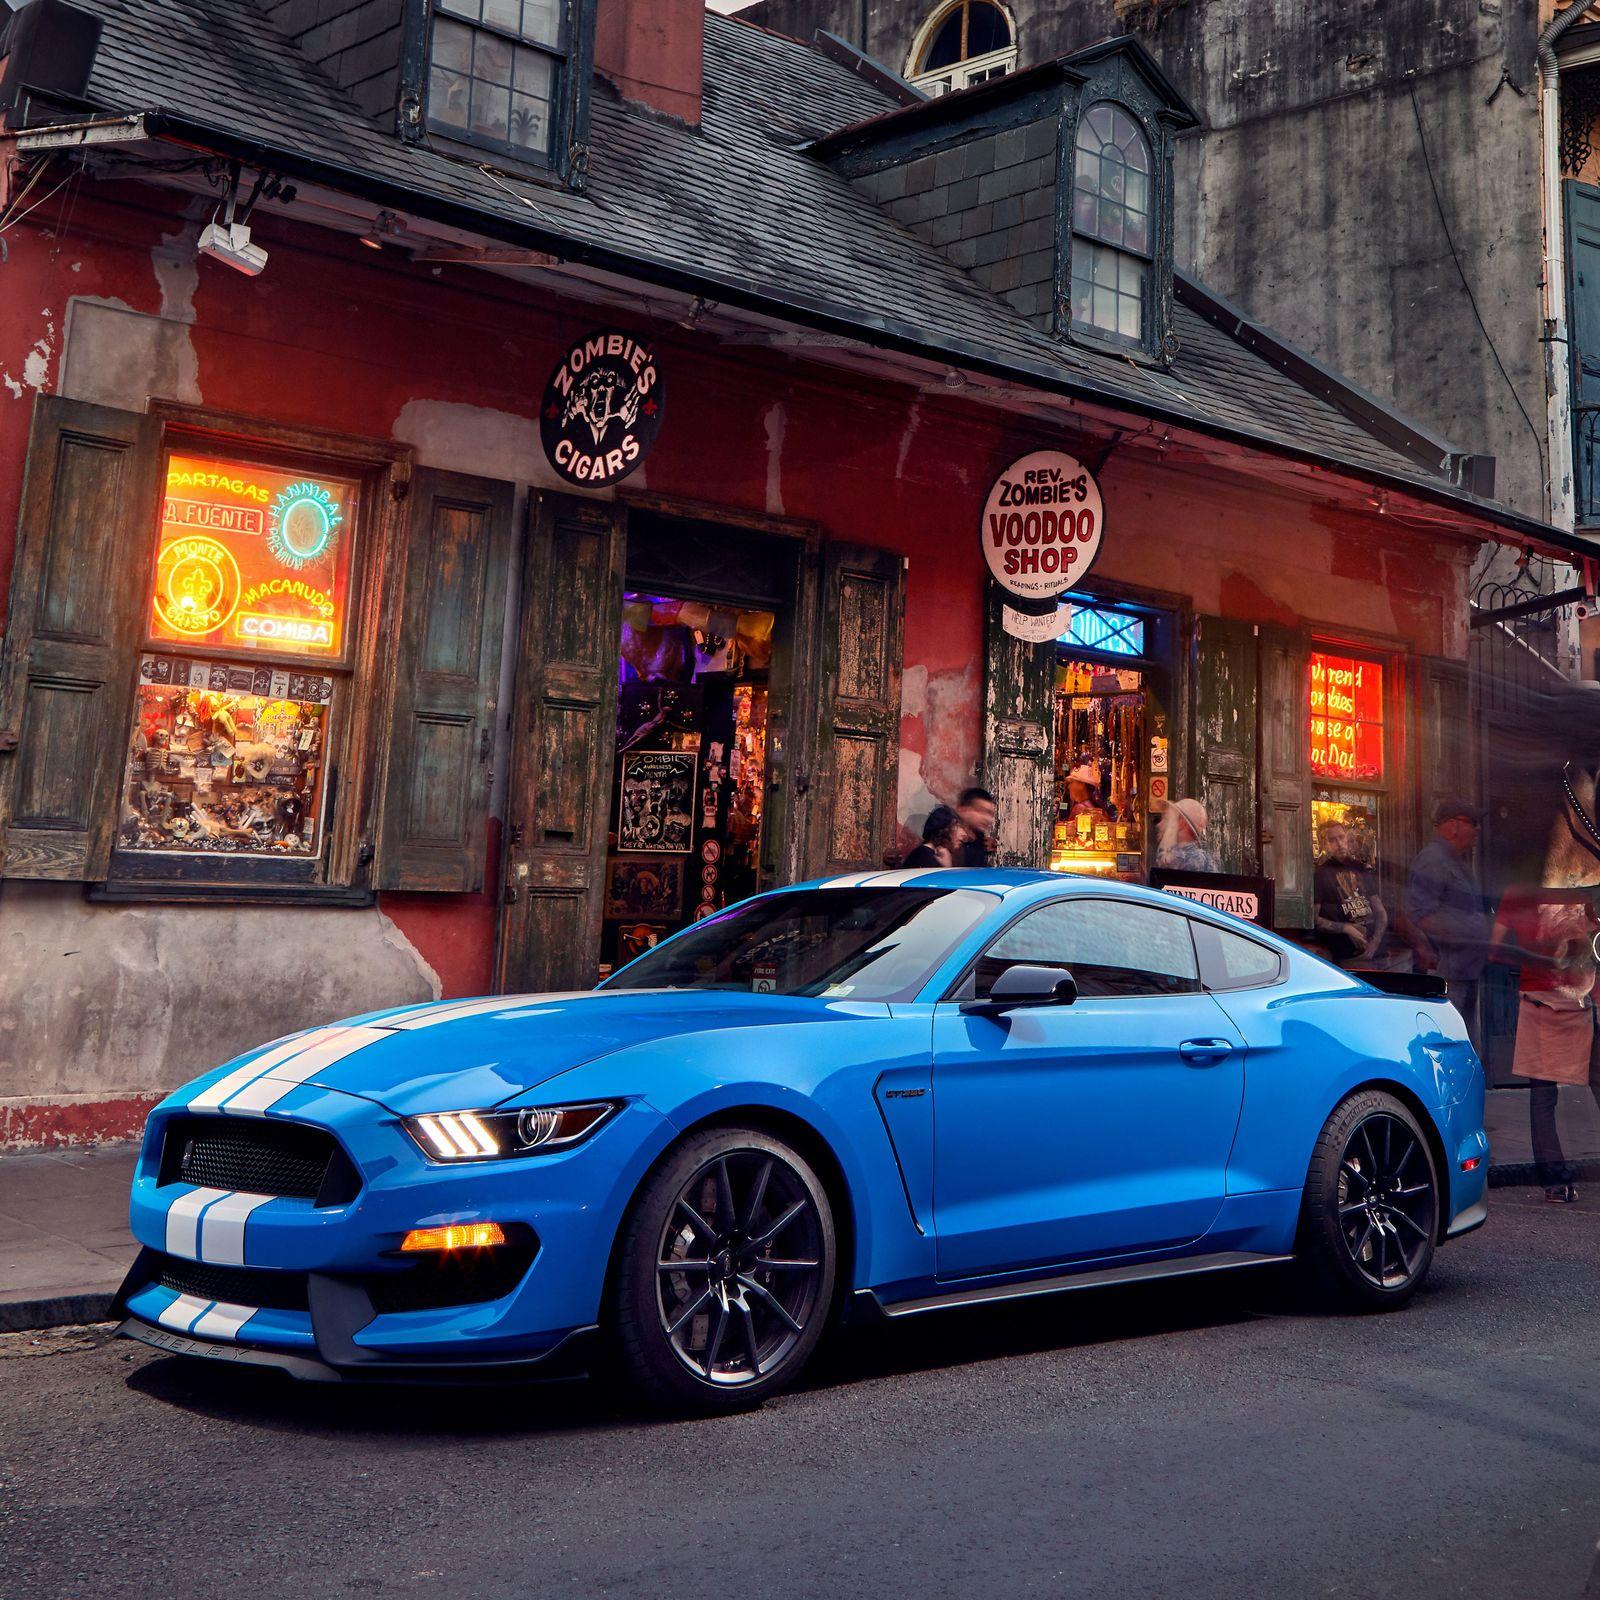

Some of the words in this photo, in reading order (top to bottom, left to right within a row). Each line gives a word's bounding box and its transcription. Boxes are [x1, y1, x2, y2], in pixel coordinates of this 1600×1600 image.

[553, 334, 656, 397] ZOMBIE'S
[555, 434, 640, 480] CIGARS
[166, 471, 270, 503] PARTAGAS
[1024, 468, 1064, 485] REV.
[998, 475, 1088, 507] ZOMBIE'S
[989, 508, 1095, 547] VOODOO
[173, 542, 224, 564] MONTE
[1003, 546, 1079, 575] SHOP
[1044, 576, 1069, 590] RITUALS
[243, 579, 335, 617] MACANUDO
[243, 618, 328, 643] COHIBA
[1011, 612, 1028, 625] HELP
[626, 755, 689, 772] ZOMBIE
[1201, 893, 1253, 914] CIGARS
[1344, 1099, 1374, 1126] MICHELIN
